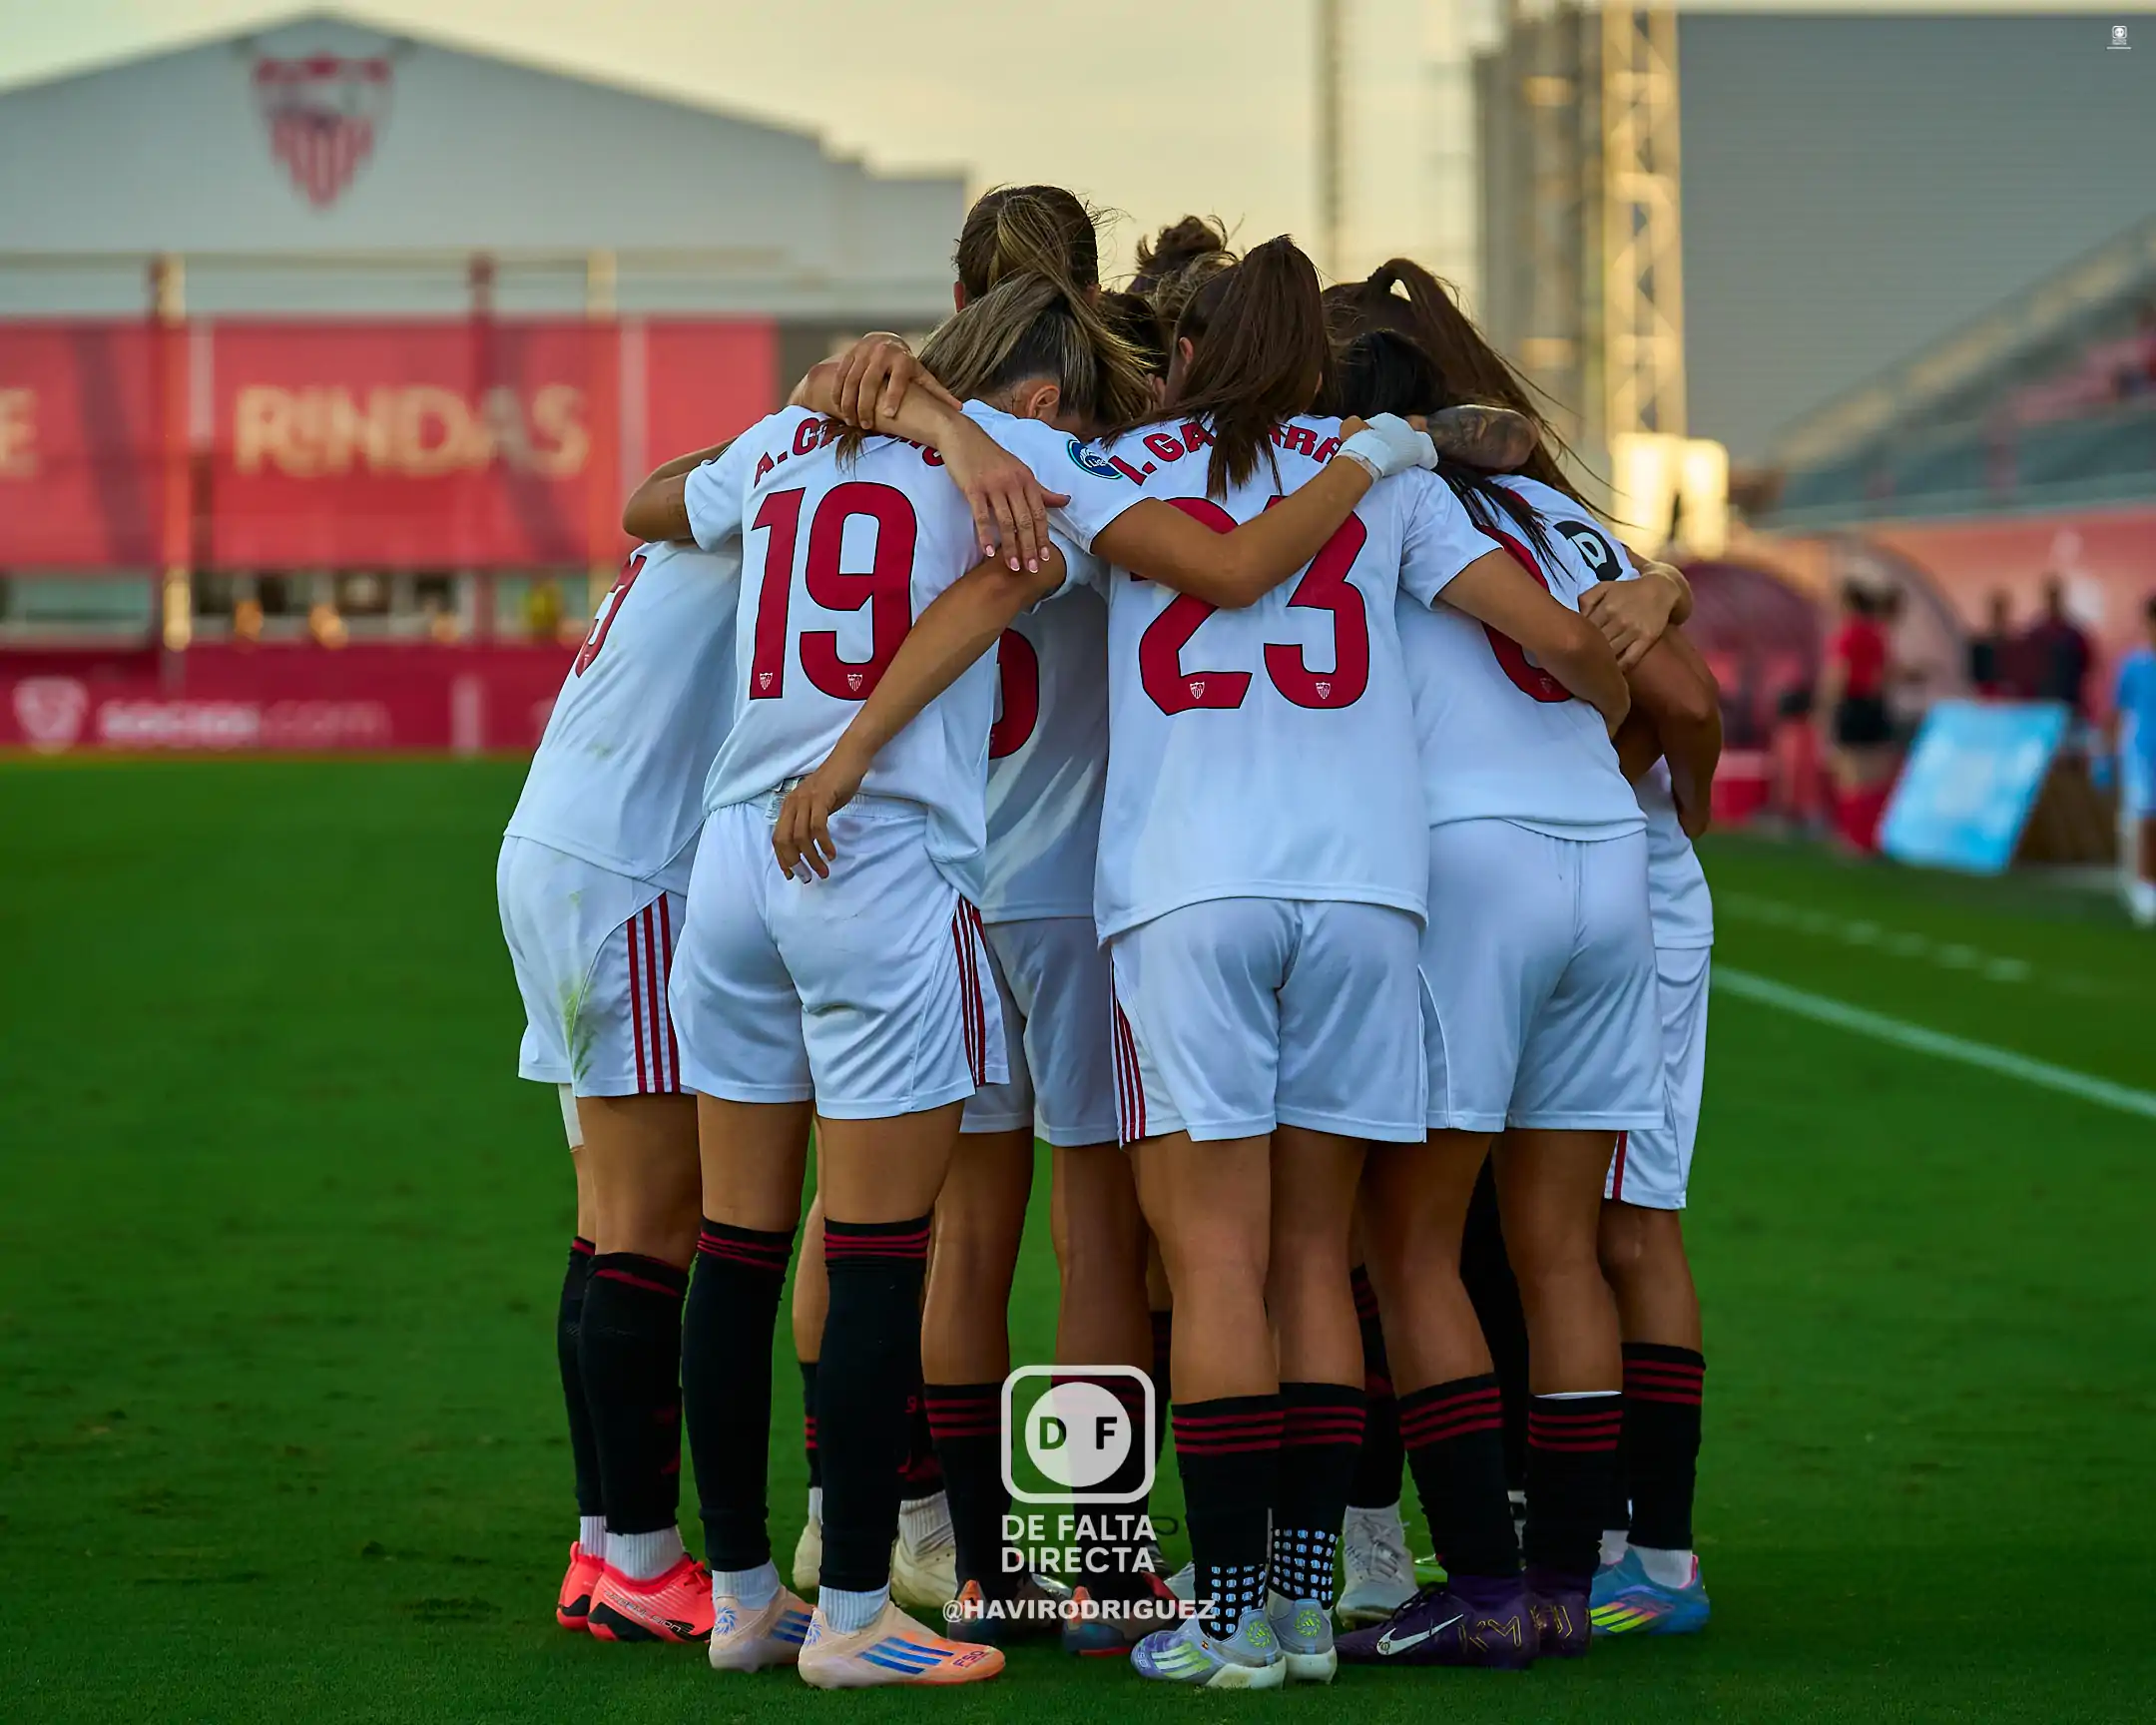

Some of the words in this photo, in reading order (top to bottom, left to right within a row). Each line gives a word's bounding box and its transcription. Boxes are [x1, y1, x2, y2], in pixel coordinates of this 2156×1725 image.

[234, 383, 591, 478] RINDAS
[750, 481, 918, 701] 19
[1130, 495, 1370, 716] 23
